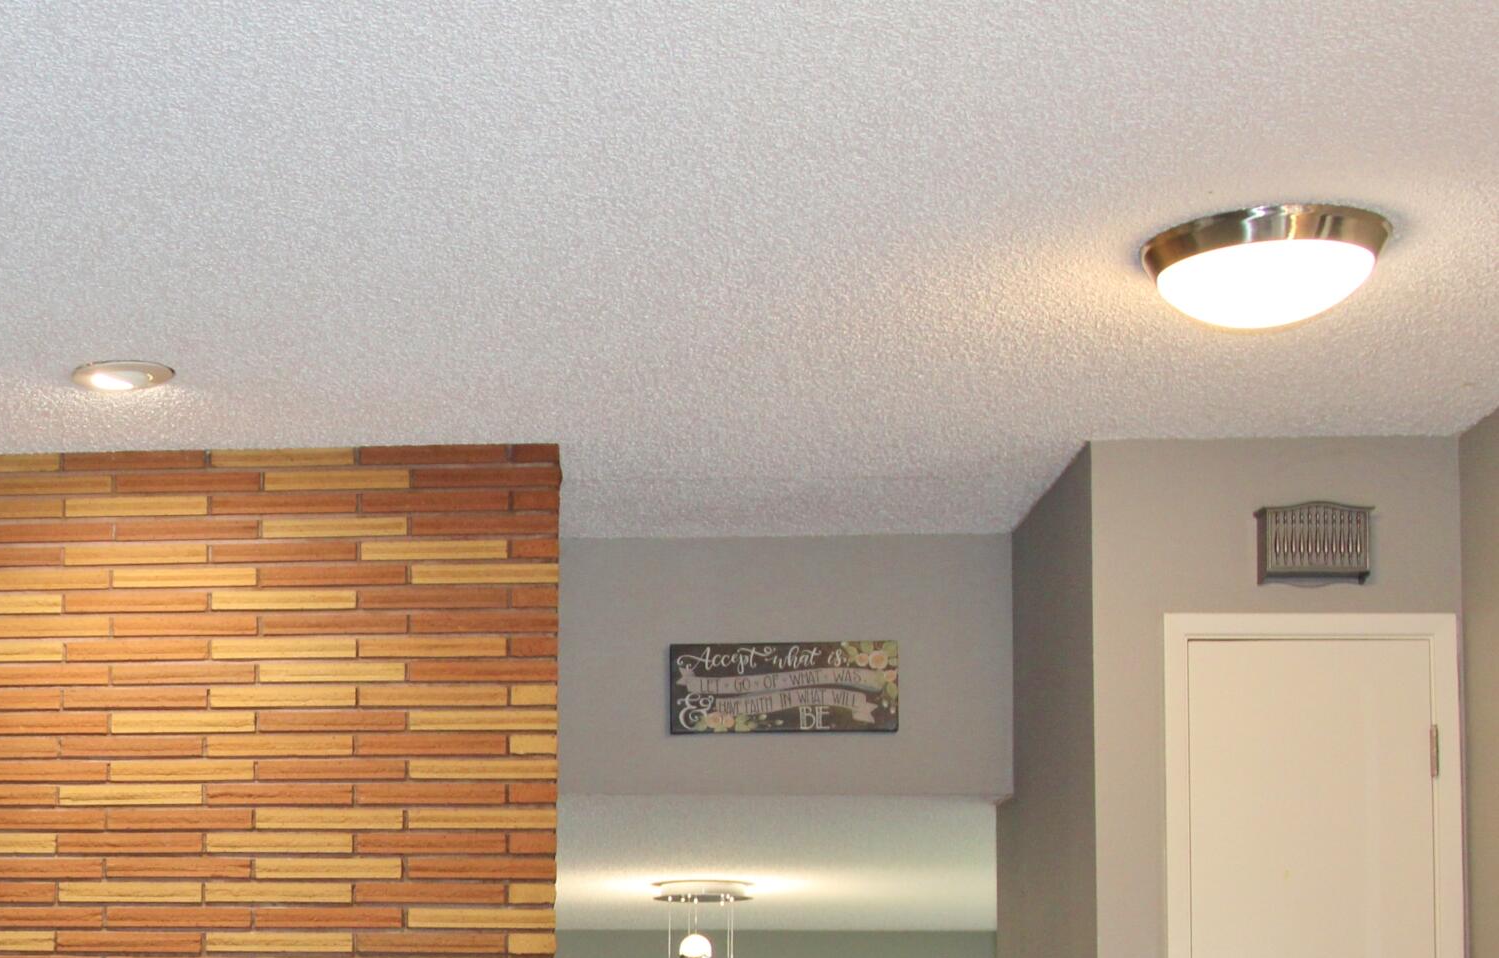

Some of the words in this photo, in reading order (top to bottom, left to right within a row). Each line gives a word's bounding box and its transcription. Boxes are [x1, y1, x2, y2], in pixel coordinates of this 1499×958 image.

[677, 646, 770, 675] Accept
[773, 645, 822, 669] what
[700, 679, 720, 697] LET
[734, 677, 751, 693] GO
[789, 670, 821, 687] WHAT
[744, 696, 773, 714] FAITH
[779, 691, 793, 708] IN
[798, 687, 826, 705] WHAT
[832, 689, 859, 707] WILL
